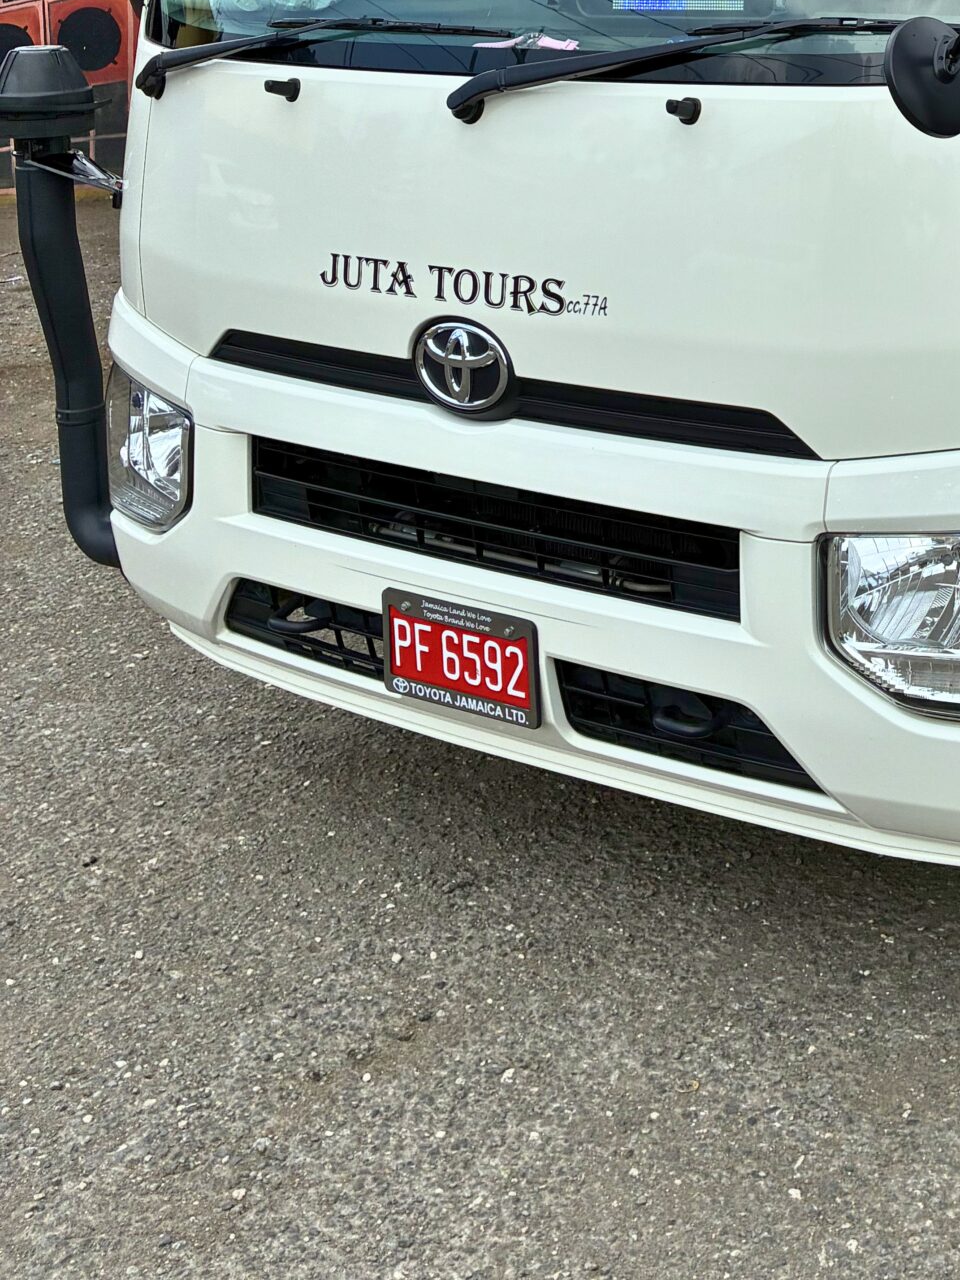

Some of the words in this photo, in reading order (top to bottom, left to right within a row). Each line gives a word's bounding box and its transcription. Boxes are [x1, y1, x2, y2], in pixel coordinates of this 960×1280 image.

[320, 253, 417, 299] JUTA
[428, 265, 566, 316] TOURS
[421, 600, 448, 612] Jamaica
[449, 606, 466, 616] Land
[467, 611, 476, 619] We
[477, 613, 491, 622] Love
[423, 610, 443, 620] Toyota
[444, 616, 464, 626] Brand
[476, 623, 490, 632] Love
[393, 618, 431, 671] PF
[441, 630, 525, 698] 6592
[410, 682, 452, 704] TOYOTA
[454, 694, 503, 717] JAMAICA
[505, 708, 528, 725] LTD.
